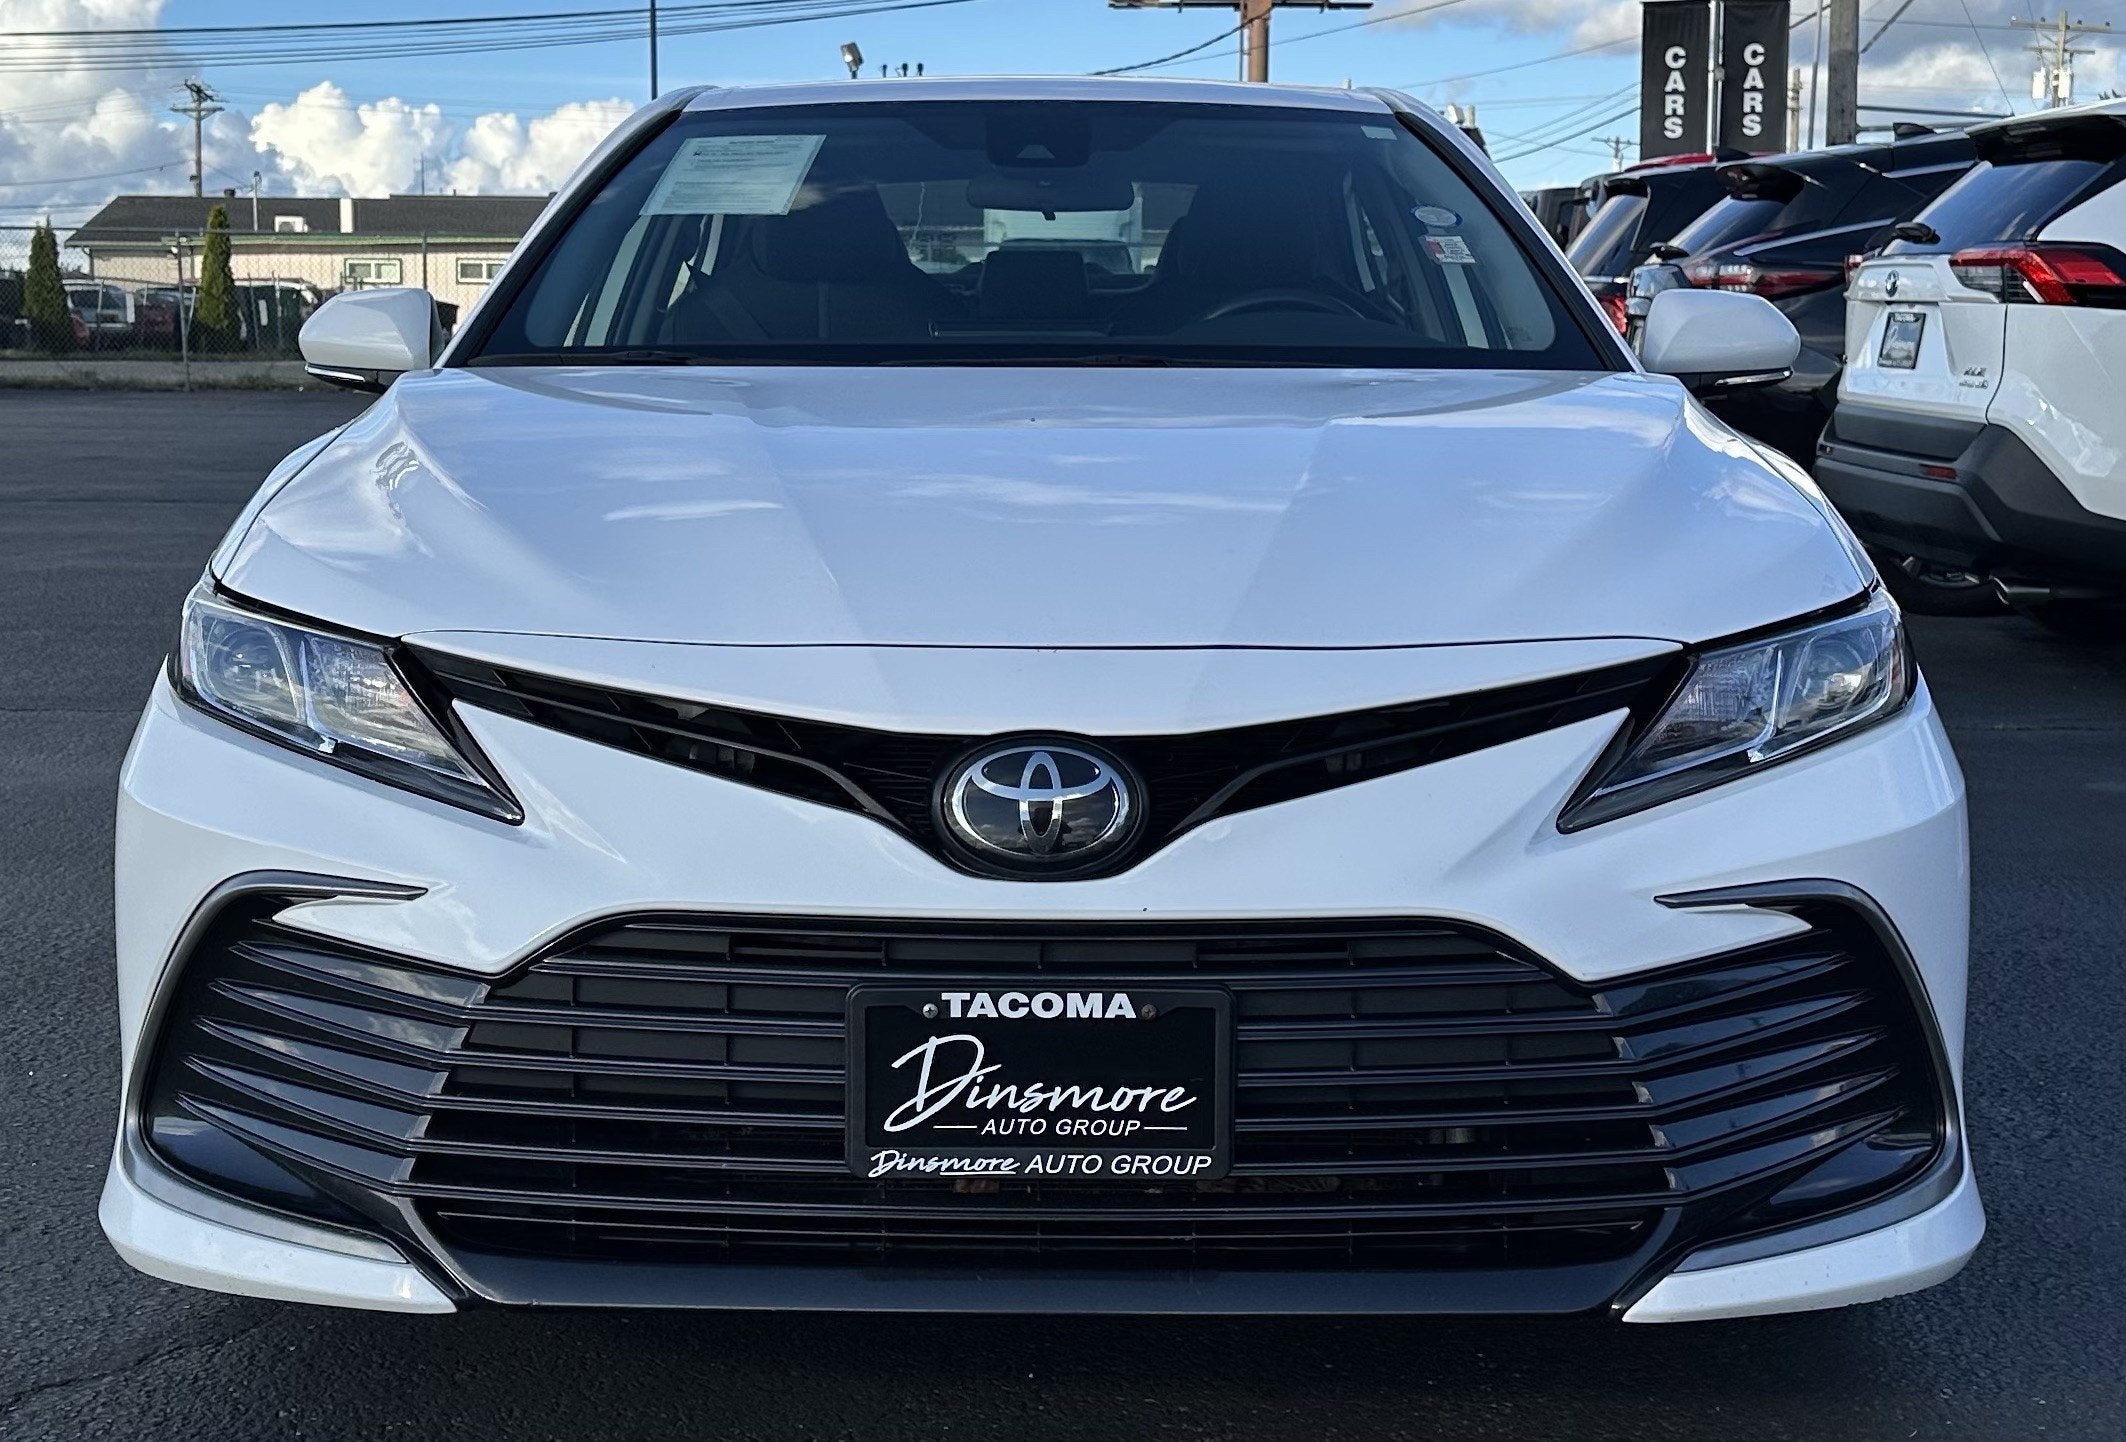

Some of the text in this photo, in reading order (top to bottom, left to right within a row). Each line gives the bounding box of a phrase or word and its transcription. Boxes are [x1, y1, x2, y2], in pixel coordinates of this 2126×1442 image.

[1664, 45, 1687, 139] CARS
[1743, 42, 1765, 137] CARS
[941, 991, 1137, 1019] TACOMA
[883, 1034, 1197, 1132] Dinsmore
[980, 1118, 1141, 1136] AUTO GROUP
[867, 1149, 1212, 1178] Dinsmore AUTO GROUP
